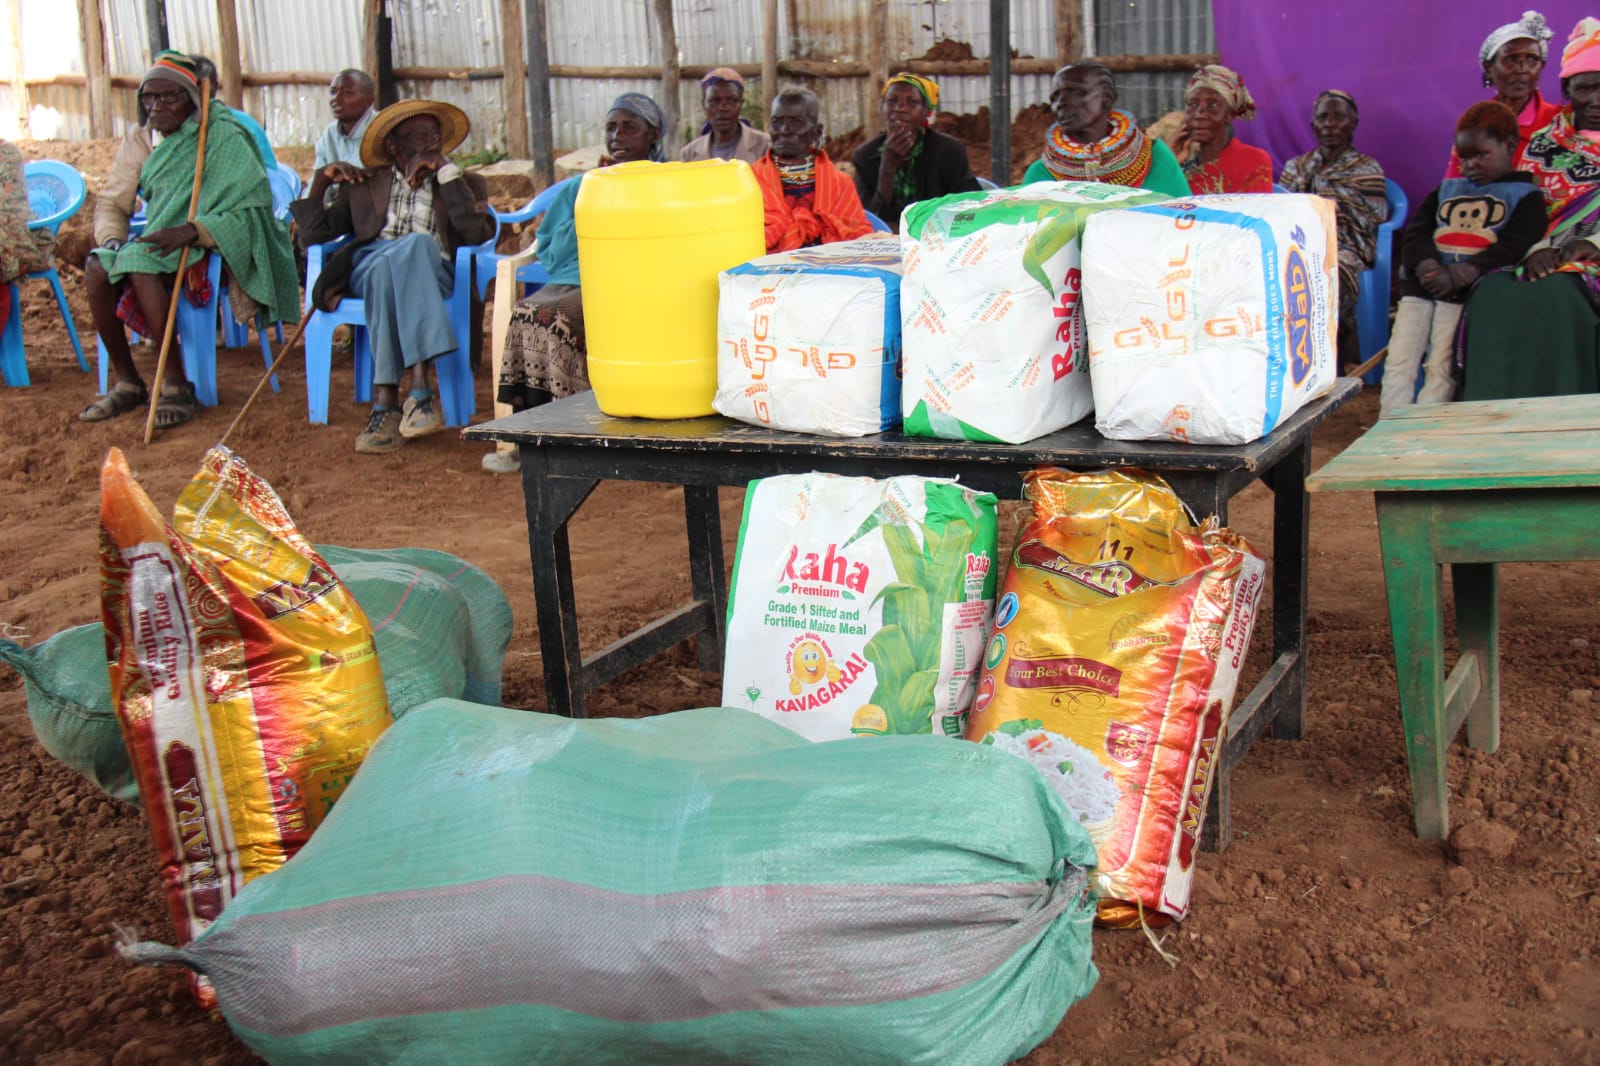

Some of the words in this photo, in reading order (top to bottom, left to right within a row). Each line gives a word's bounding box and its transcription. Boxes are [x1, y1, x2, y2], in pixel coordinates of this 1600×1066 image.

[1266, 249, 1275, 281] MORE
[1268, 283, 1279, 312] DOES
[1051, 267, 1082, 384] Raha
[1073, 302, 1081, 350] Premiu
[1269, 379, 1279, 400] THE
[778, 543, 870, 594] Raha
[768, 600, 797, 614] Grade
[800, 603, 806, 615] 1
[809, 604, 838, 619] Sifted
[839, 609, 860, 620] and
[791, 582, 840, 598] Premium
[153, 592, 173, 632] Rice
[764, 614, 807, 629] Fortified
[809, 618, 836, 633] Maize
[839, 623, 867, 635] Meal
[1224, 578, 1249, 651] Premium
[1231, 610, 1251, 670] Quality
[1246, 573, 1259, 607] Rice
[138, 609, 166, 688] Premium
[1111, 635, 1168, 650] GUARANTEED
[160, 636, 182, 700] Quality
[775, 652, 868, 712] KAVAGARA!
[1008, 665, 1034, 679] Your
[1036, 667, 1064, 678] Best
[1067, 664, 1116, 686] Choice
[1115, 730, 1139, 748] 25
[1181, 736, 1217, 837] MARA
